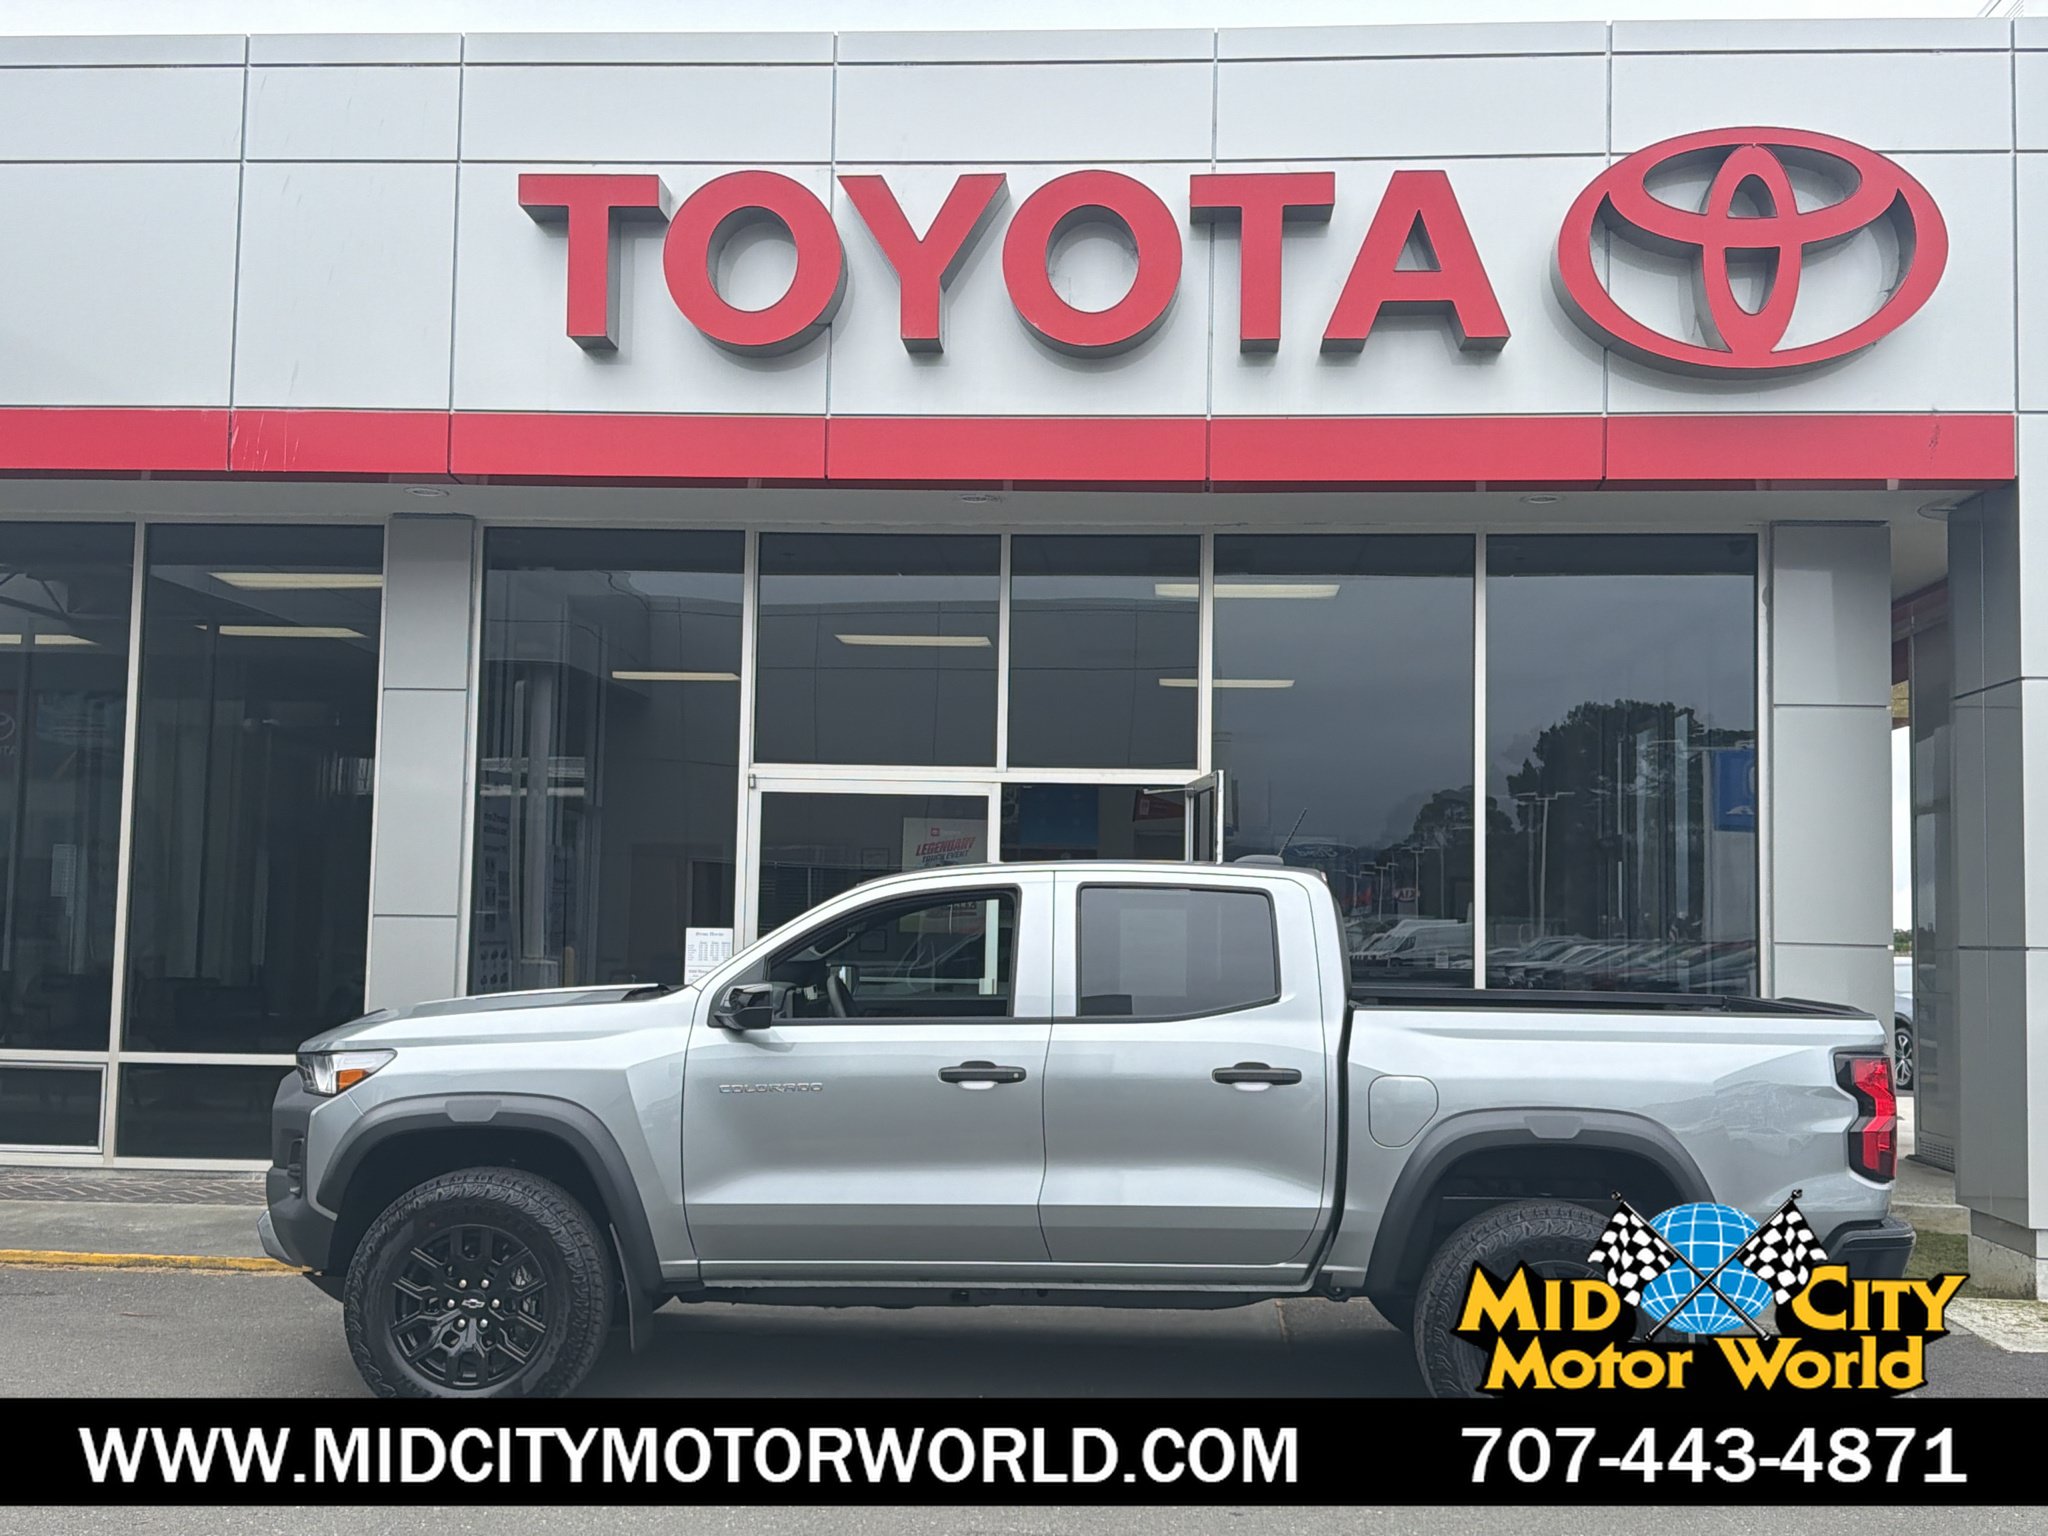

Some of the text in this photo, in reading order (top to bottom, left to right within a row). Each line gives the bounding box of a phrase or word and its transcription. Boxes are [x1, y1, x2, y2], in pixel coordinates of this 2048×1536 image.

[519, 170, 1511, 353] TOYOTA
[915, 836, 976, 857] LEGENDARY
[719, 1082, 823, 1094] COLORADO
